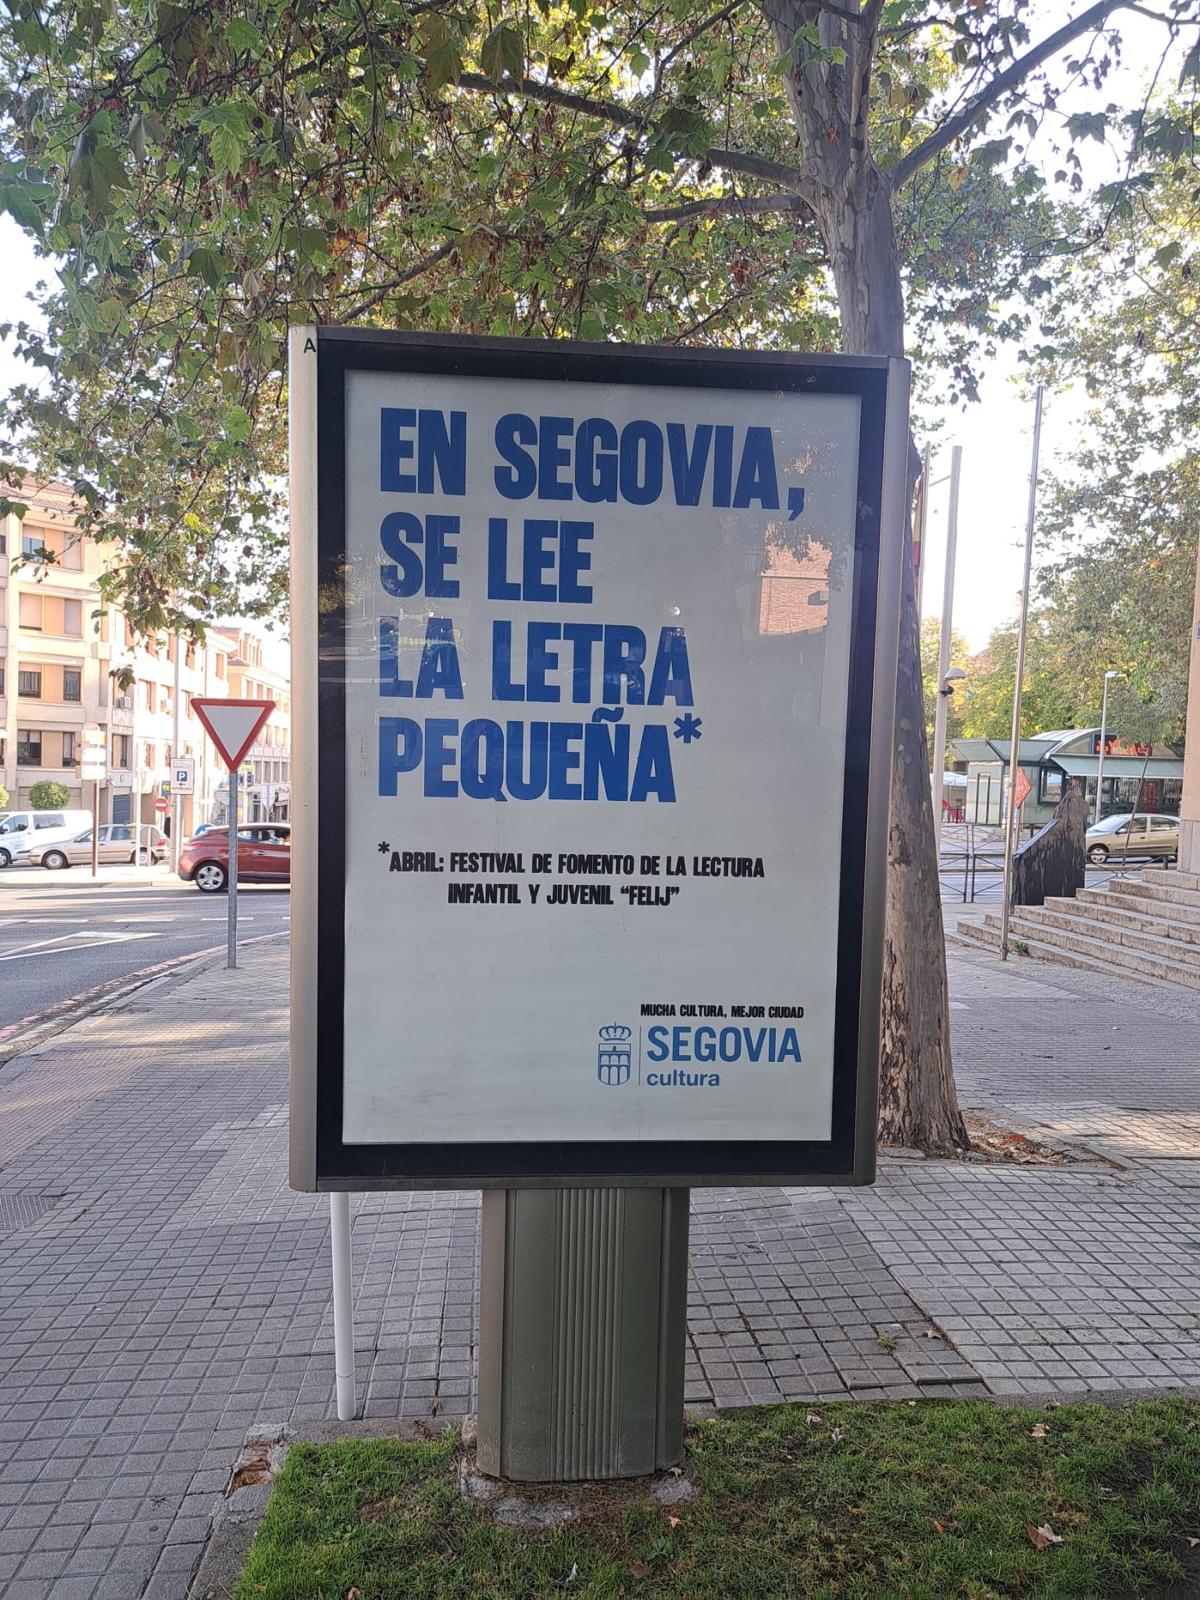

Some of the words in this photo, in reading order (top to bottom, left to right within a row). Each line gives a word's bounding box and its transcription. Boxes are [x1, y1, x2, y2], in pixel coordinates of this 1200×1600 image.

[303, 337, 317, 354] A
[380, 407, 467, 496] EN
[493, 413, 805, 521] SEGOVIA,
[379, 512, 460, 599] SE
[487, 518, 595, 604] LEE
[378, 615, 464, 700] LA
[492, 620, 694, 706] LETRA
[450, 852, 526, 874] FESTIVAL
[531, 853, 553, 874] DE
[558, 853, 635, 876] FOMENTO
[640, 855, 661, 876] DE
[666, 856, 687, 877] LA
[693, 856, 766, 878] LECTURA
[448, 883, 522, 904] INFANTIL
[528, 884, 541, 905] Y
[546, 884, 614, 905] JUVENIL
[640, 1003, 676, 1017] MUCHA
[680, 1004, 728, 1019] CULTURA,
[731, 1005, 766, 1018] MEJOR
[768, 1006, 804, 1019] CIUDAD
[646, 1025, 802, 1063] SEGOVIA
[646, 1069, 721, 1087] cultura
